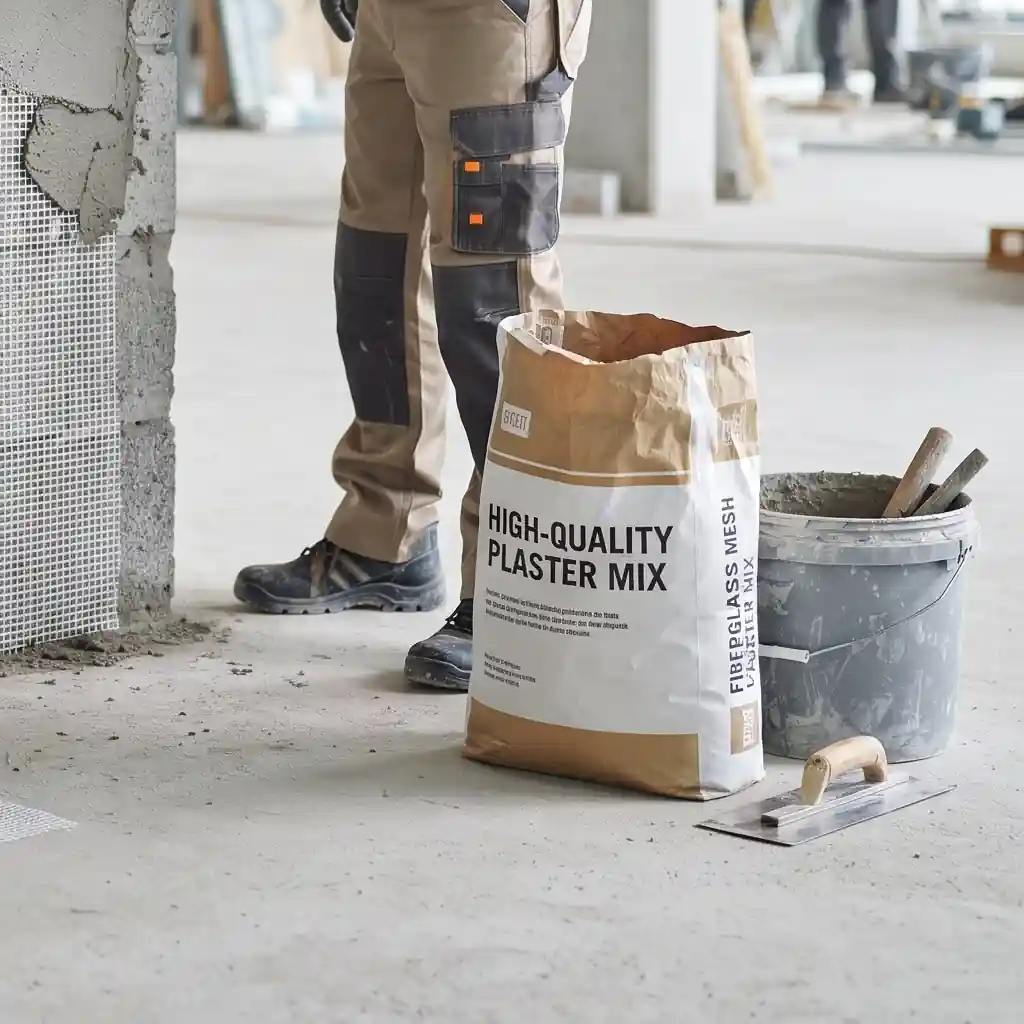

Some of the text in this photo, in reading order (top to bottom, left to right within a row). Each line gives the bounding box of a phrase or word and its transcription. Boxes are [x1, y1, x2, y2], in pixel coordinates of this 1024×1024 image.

[489, 503, 673, 554] HIGH-QUALITY
[721, 497, 738, 554] MESH
[488, 539, 668, 591] PLASTER MIX
